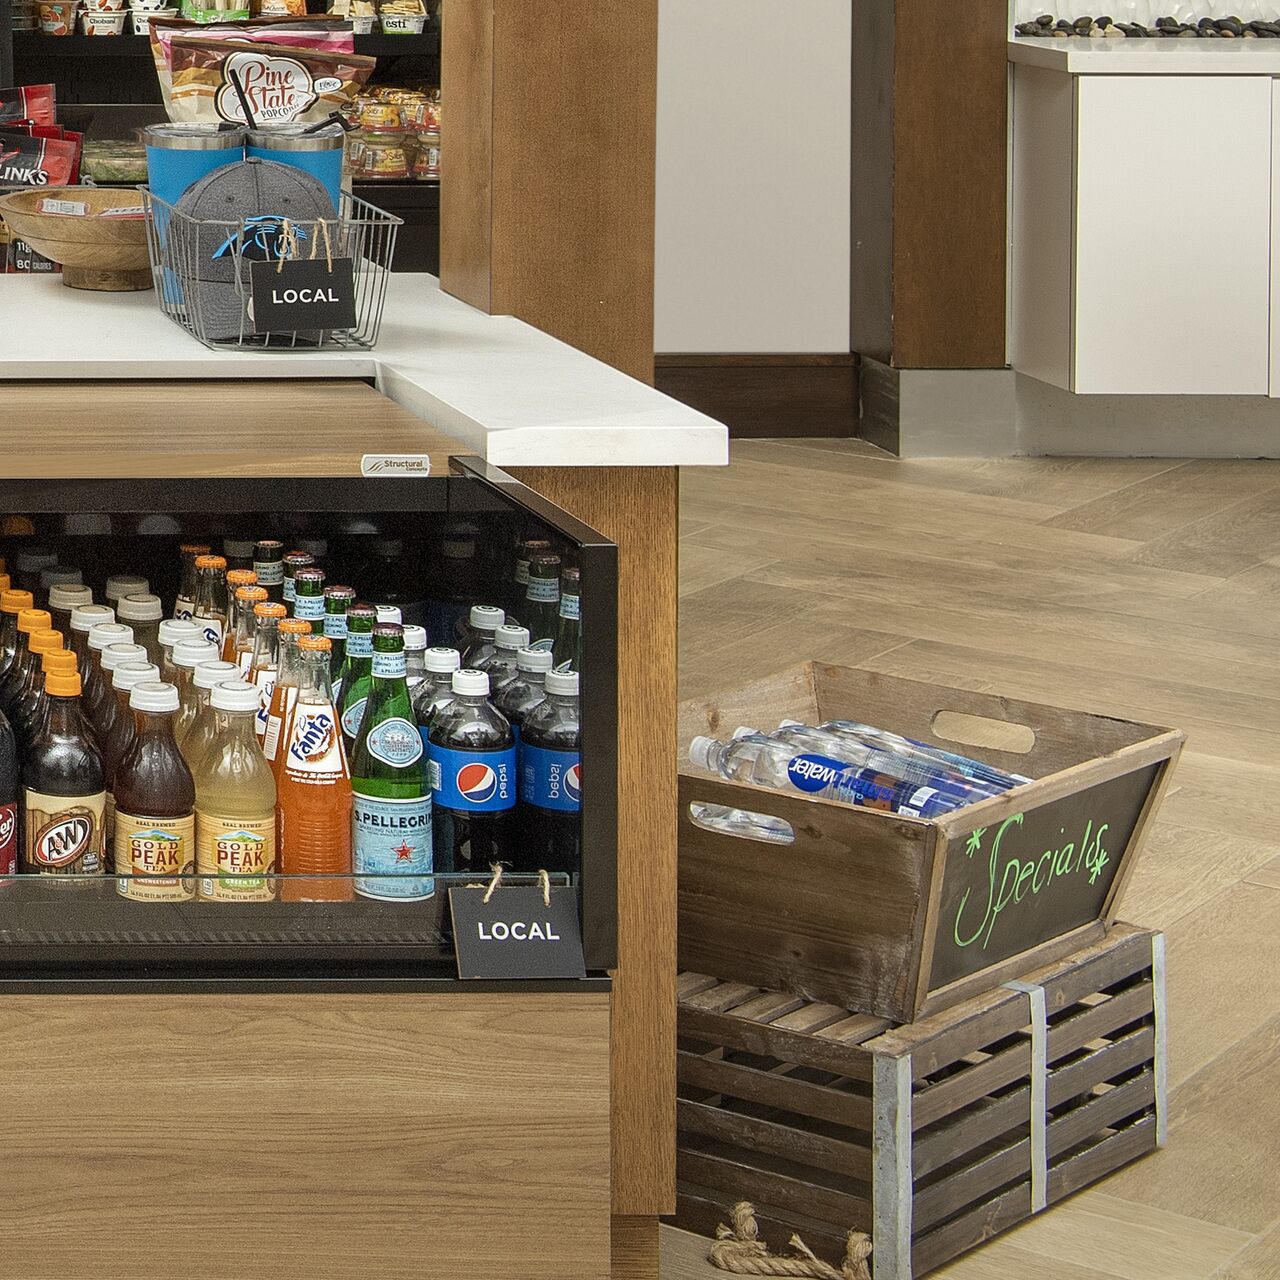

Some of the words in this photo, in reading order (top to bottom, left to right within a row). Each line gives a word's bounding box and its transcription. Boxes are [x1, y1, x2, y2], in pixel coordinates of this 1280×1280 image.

[385, 18, 407, 29] esti
[243, 62, 294, 93] Pine
[248, 86, 297, 117] State
[271, 287, 340, 304] LOCAL
[383, 460, 423, 468] Structural
[290, 712, 332, 762] Fanta
[497, 763, 508, 800] pepsi
[47, 820, 79, 861] A&W
[131, 841, 179, 850] GOLD
[217, 842, 264, 851] GOLD
[131, 849, 180, 866] PEAK
[217, 850, 265, 866] PEAK
[143, 865, 167, 873] TEA
[225, 878, 247, 886] GREEN
[477, 921, 560, 942] LOCAL
